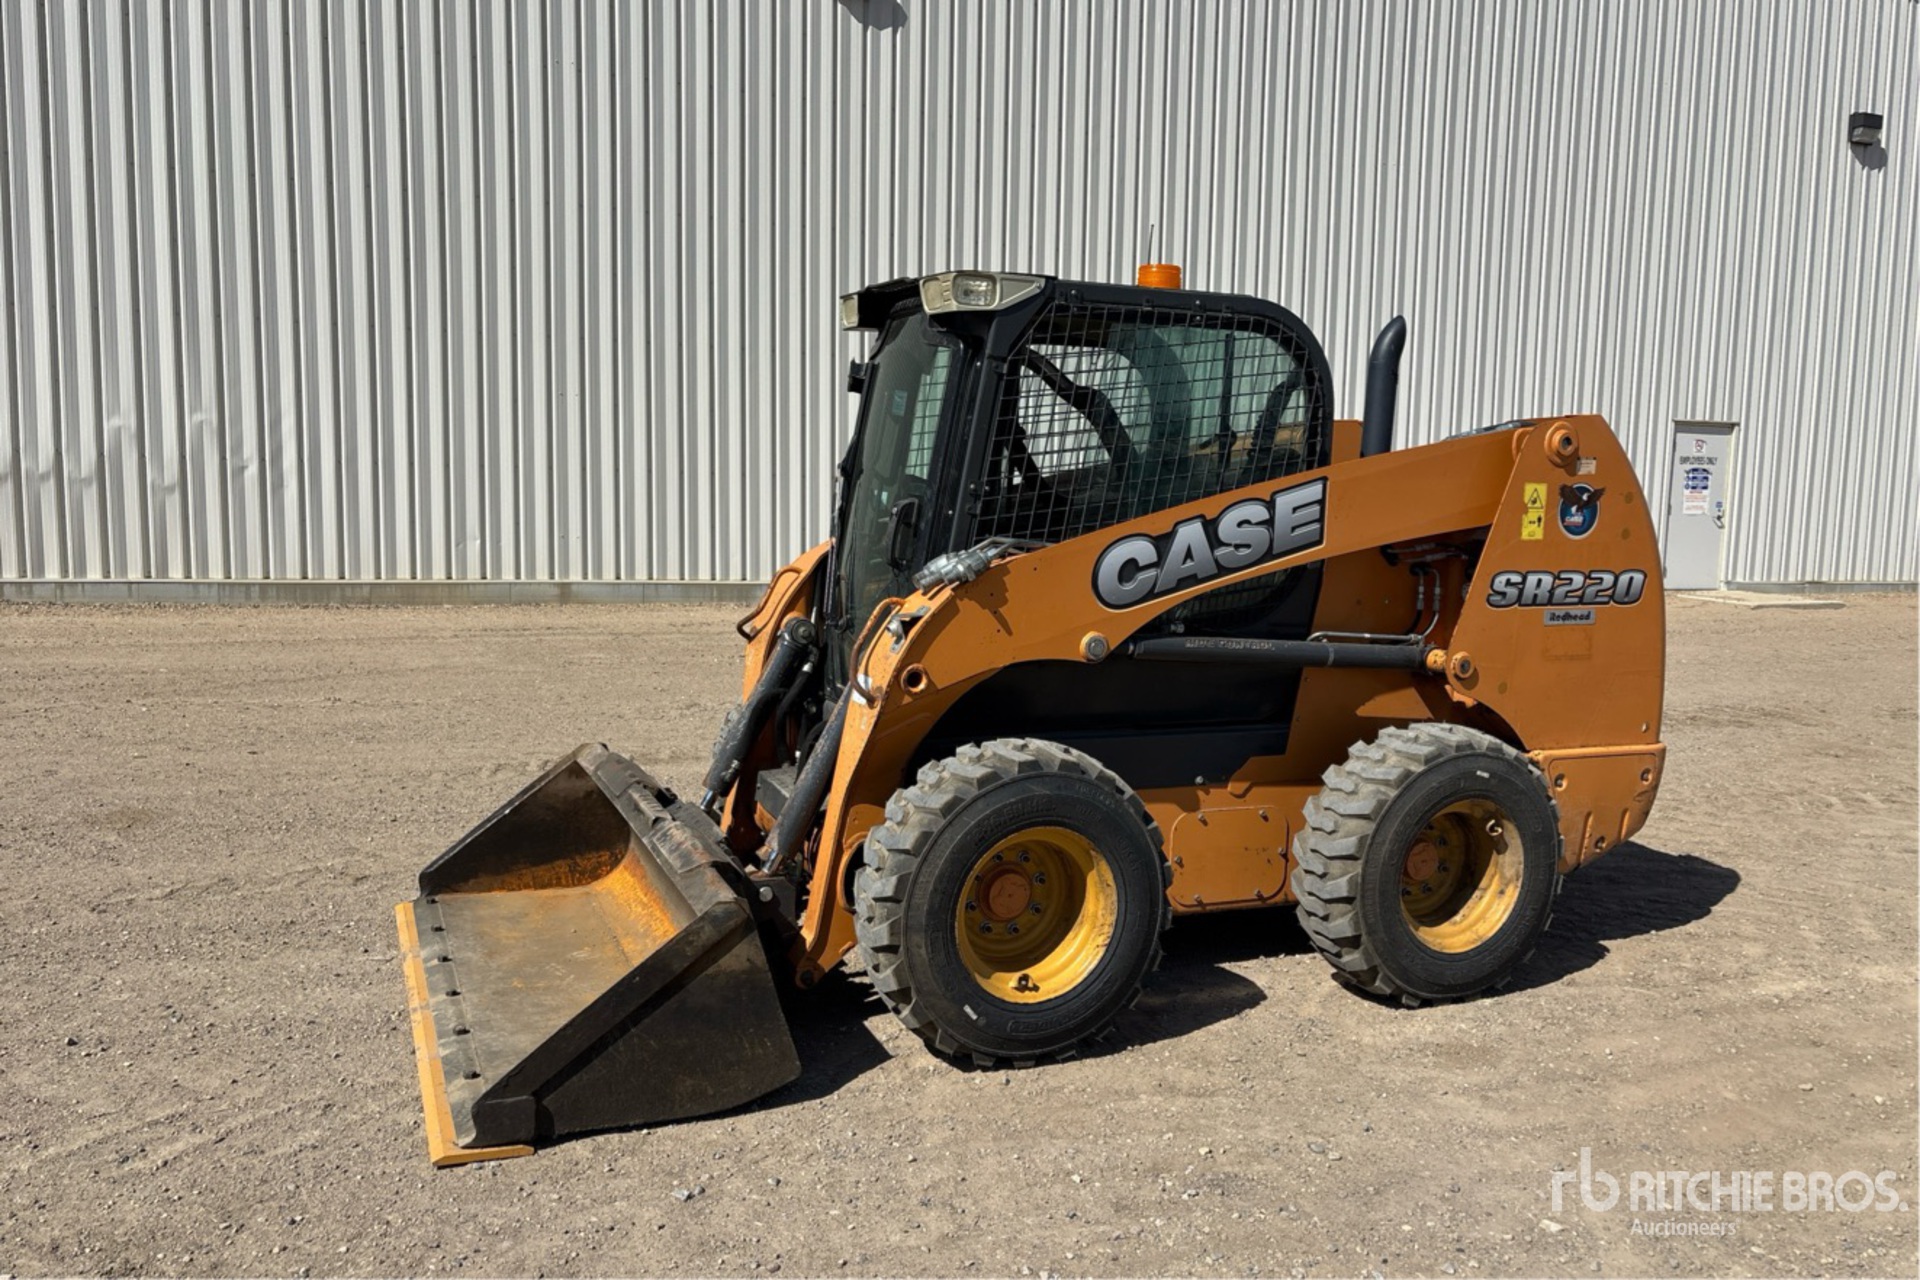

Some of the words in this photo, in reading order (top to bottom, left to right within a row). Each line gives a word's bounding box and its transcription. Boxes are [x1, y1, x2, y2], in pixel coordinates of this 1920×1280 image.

[1093, 477, 1327, 609] CASE
[1486, 569, 1648, 608] SR220
[1549, 611, 1592, 624] Redhead
